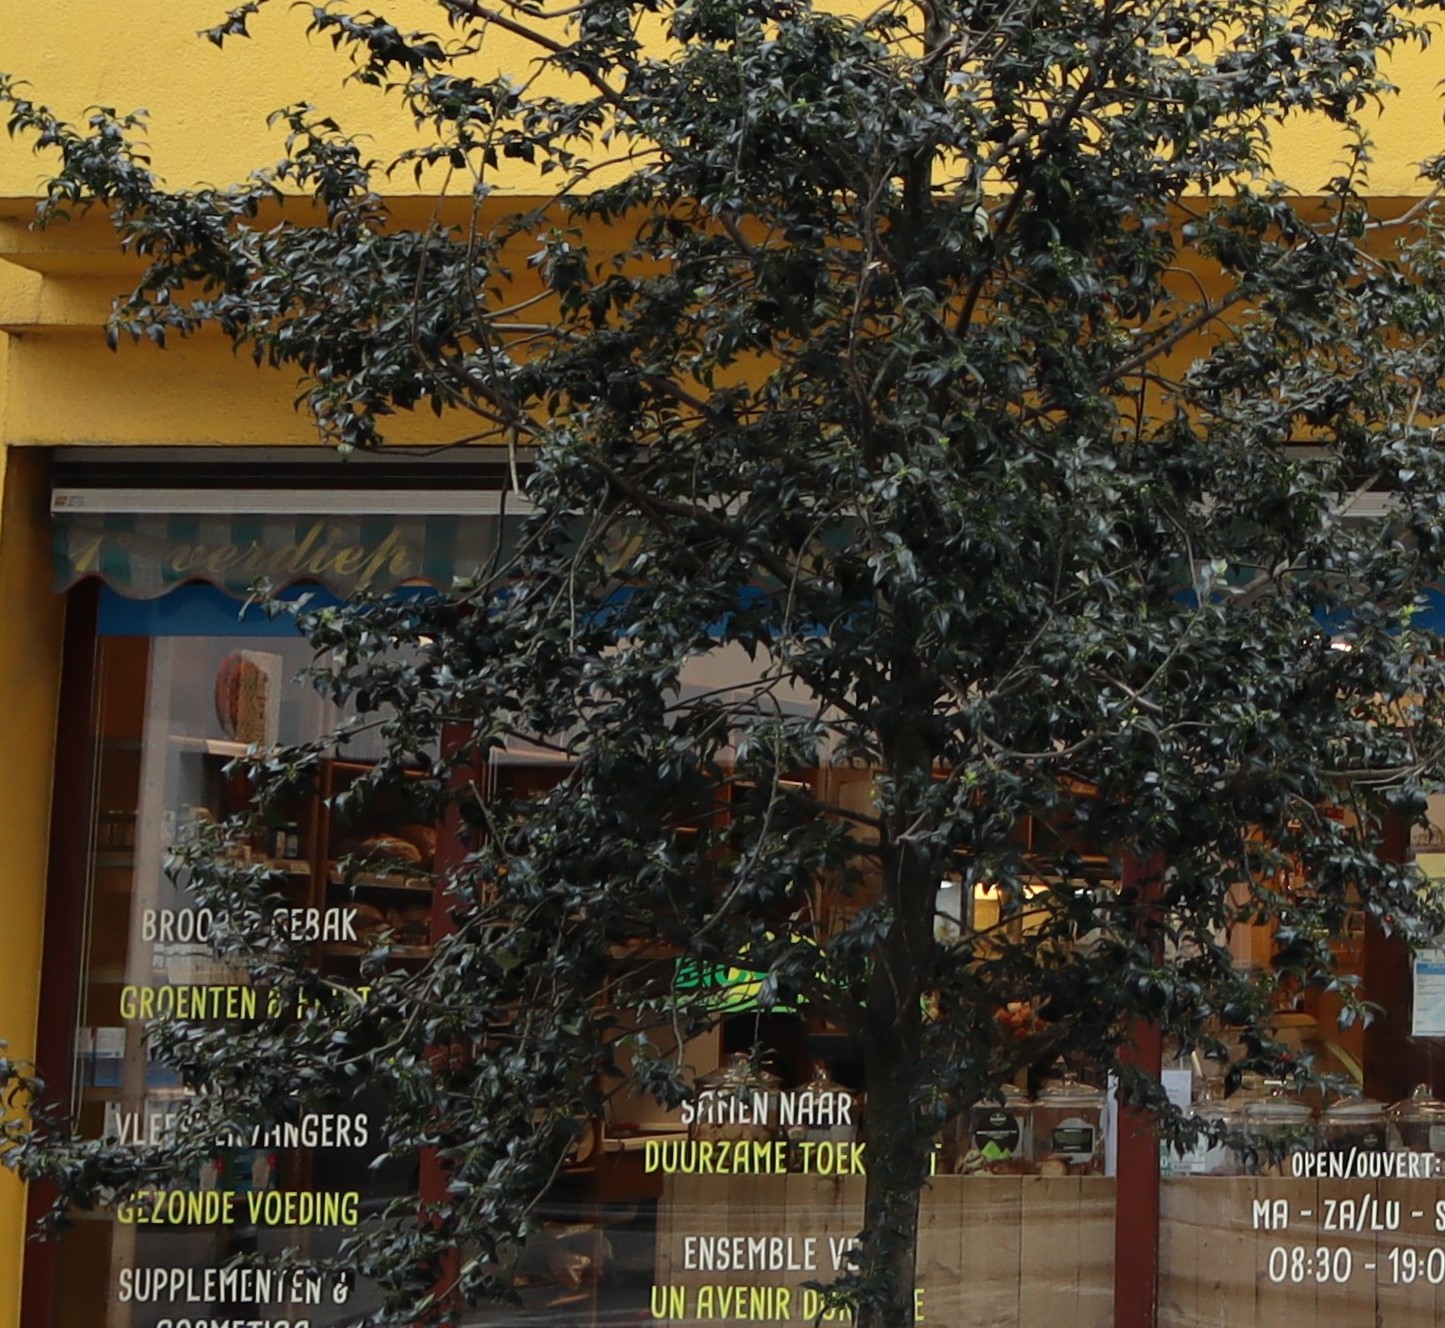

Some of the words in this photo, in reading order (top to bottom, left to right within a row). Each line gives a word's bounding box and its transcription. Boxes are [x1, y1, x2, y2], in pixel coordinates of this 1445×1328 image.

[120, 985, 256, 1020] GROENTEN
[780, 1092, 852, 1126] NAAR
[644, 1139, 787, 1174] DUURZAME
[1291, 1151, 1441, 1179] OPEN/OUVERT:
[117, 1189, 236, 1225] GEZONDE
[247, 1190, 360, 1226] VOEDING
[1252, 1200, 1289, 1231] MA
[1323, 1193, 1401, 1233] ZA/LU
[684, 1236, 817, 1272] ENSEMBLE
[1268, 1246, 1353, 1284] 08:30
[119, 1266, 323, 1305] SUPPLEMENTEN
[650, 1285, 686, 1320] UN
[696, 1285, 791, 1322] AVENIR
